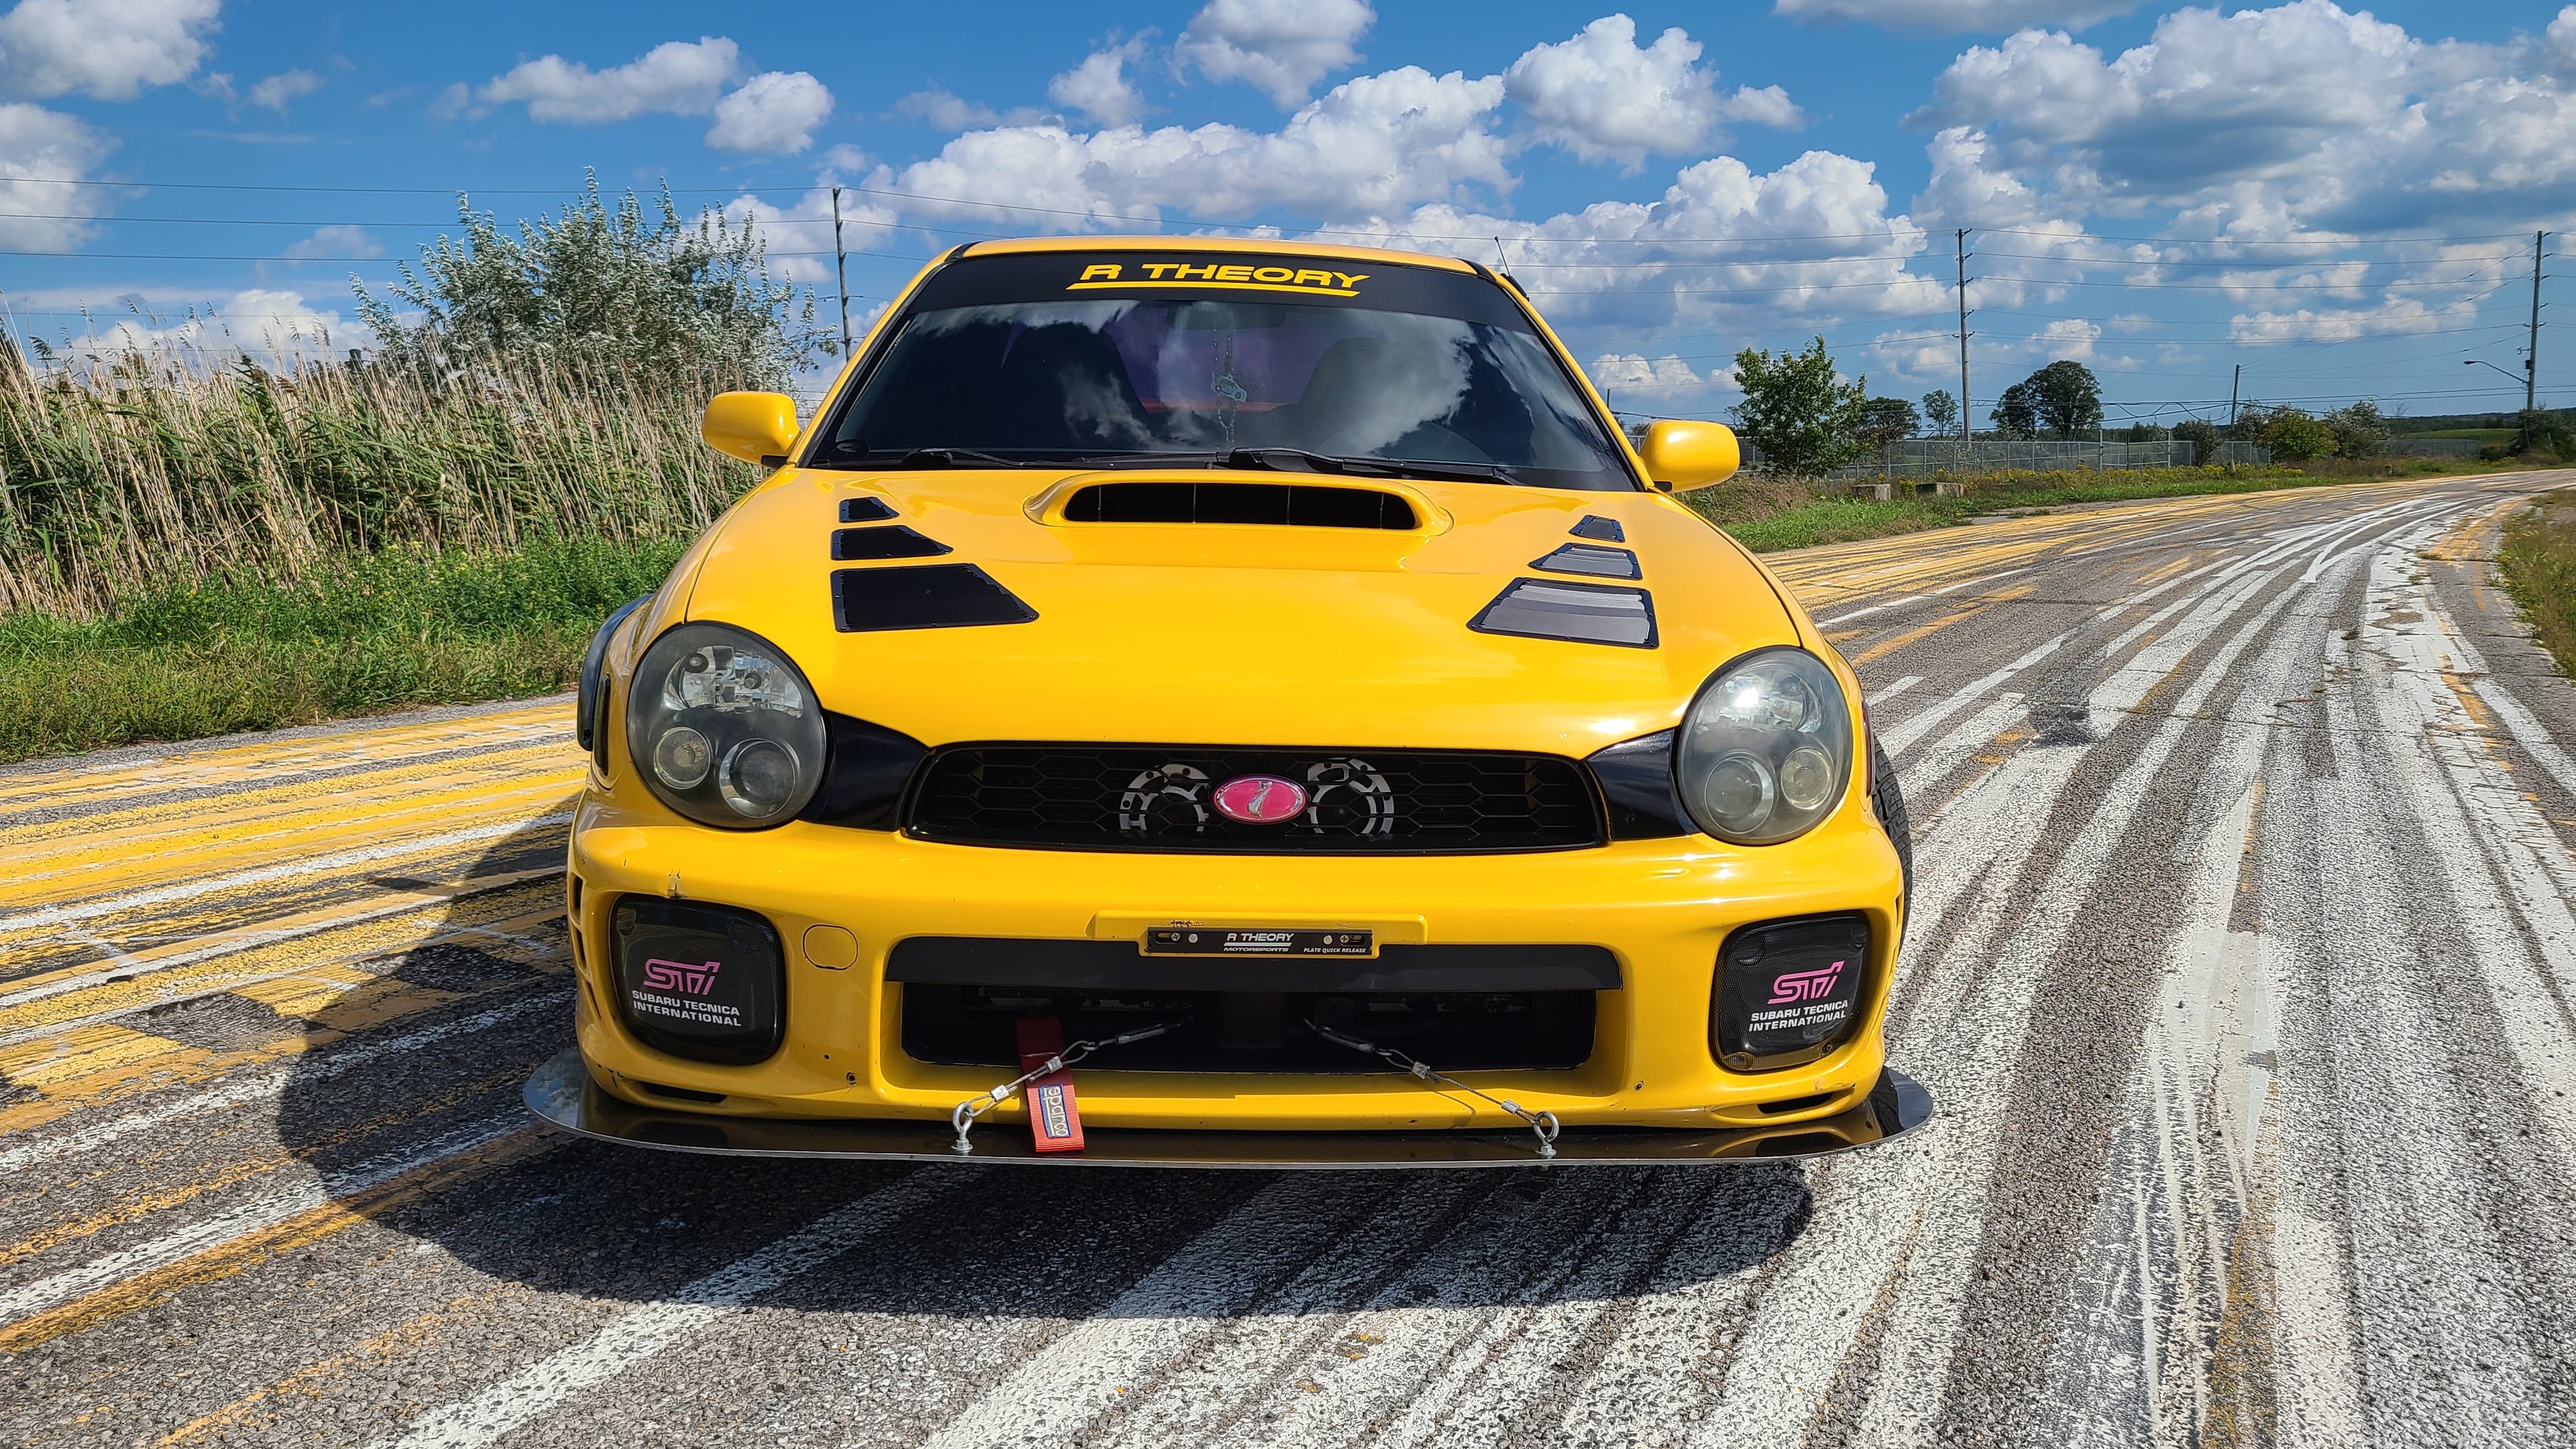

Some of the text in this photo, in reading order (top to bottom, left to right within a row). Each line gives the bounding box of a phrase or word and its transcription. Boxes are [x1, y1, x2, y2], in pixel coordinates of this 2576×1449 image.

[1079, 264, 1371, 287] R THEORY
[1226, 933, 1295, 942] R THEORY
[632, 989, 741, 1016] SUBARU TECNICA
[633, 1000, 742, 1027] INTERNATIONAL
[1752, 1000, 1848, 1021] SUBARU TECNICA
[1749, 1010, 1846, 1031] INTERNATIONAL
